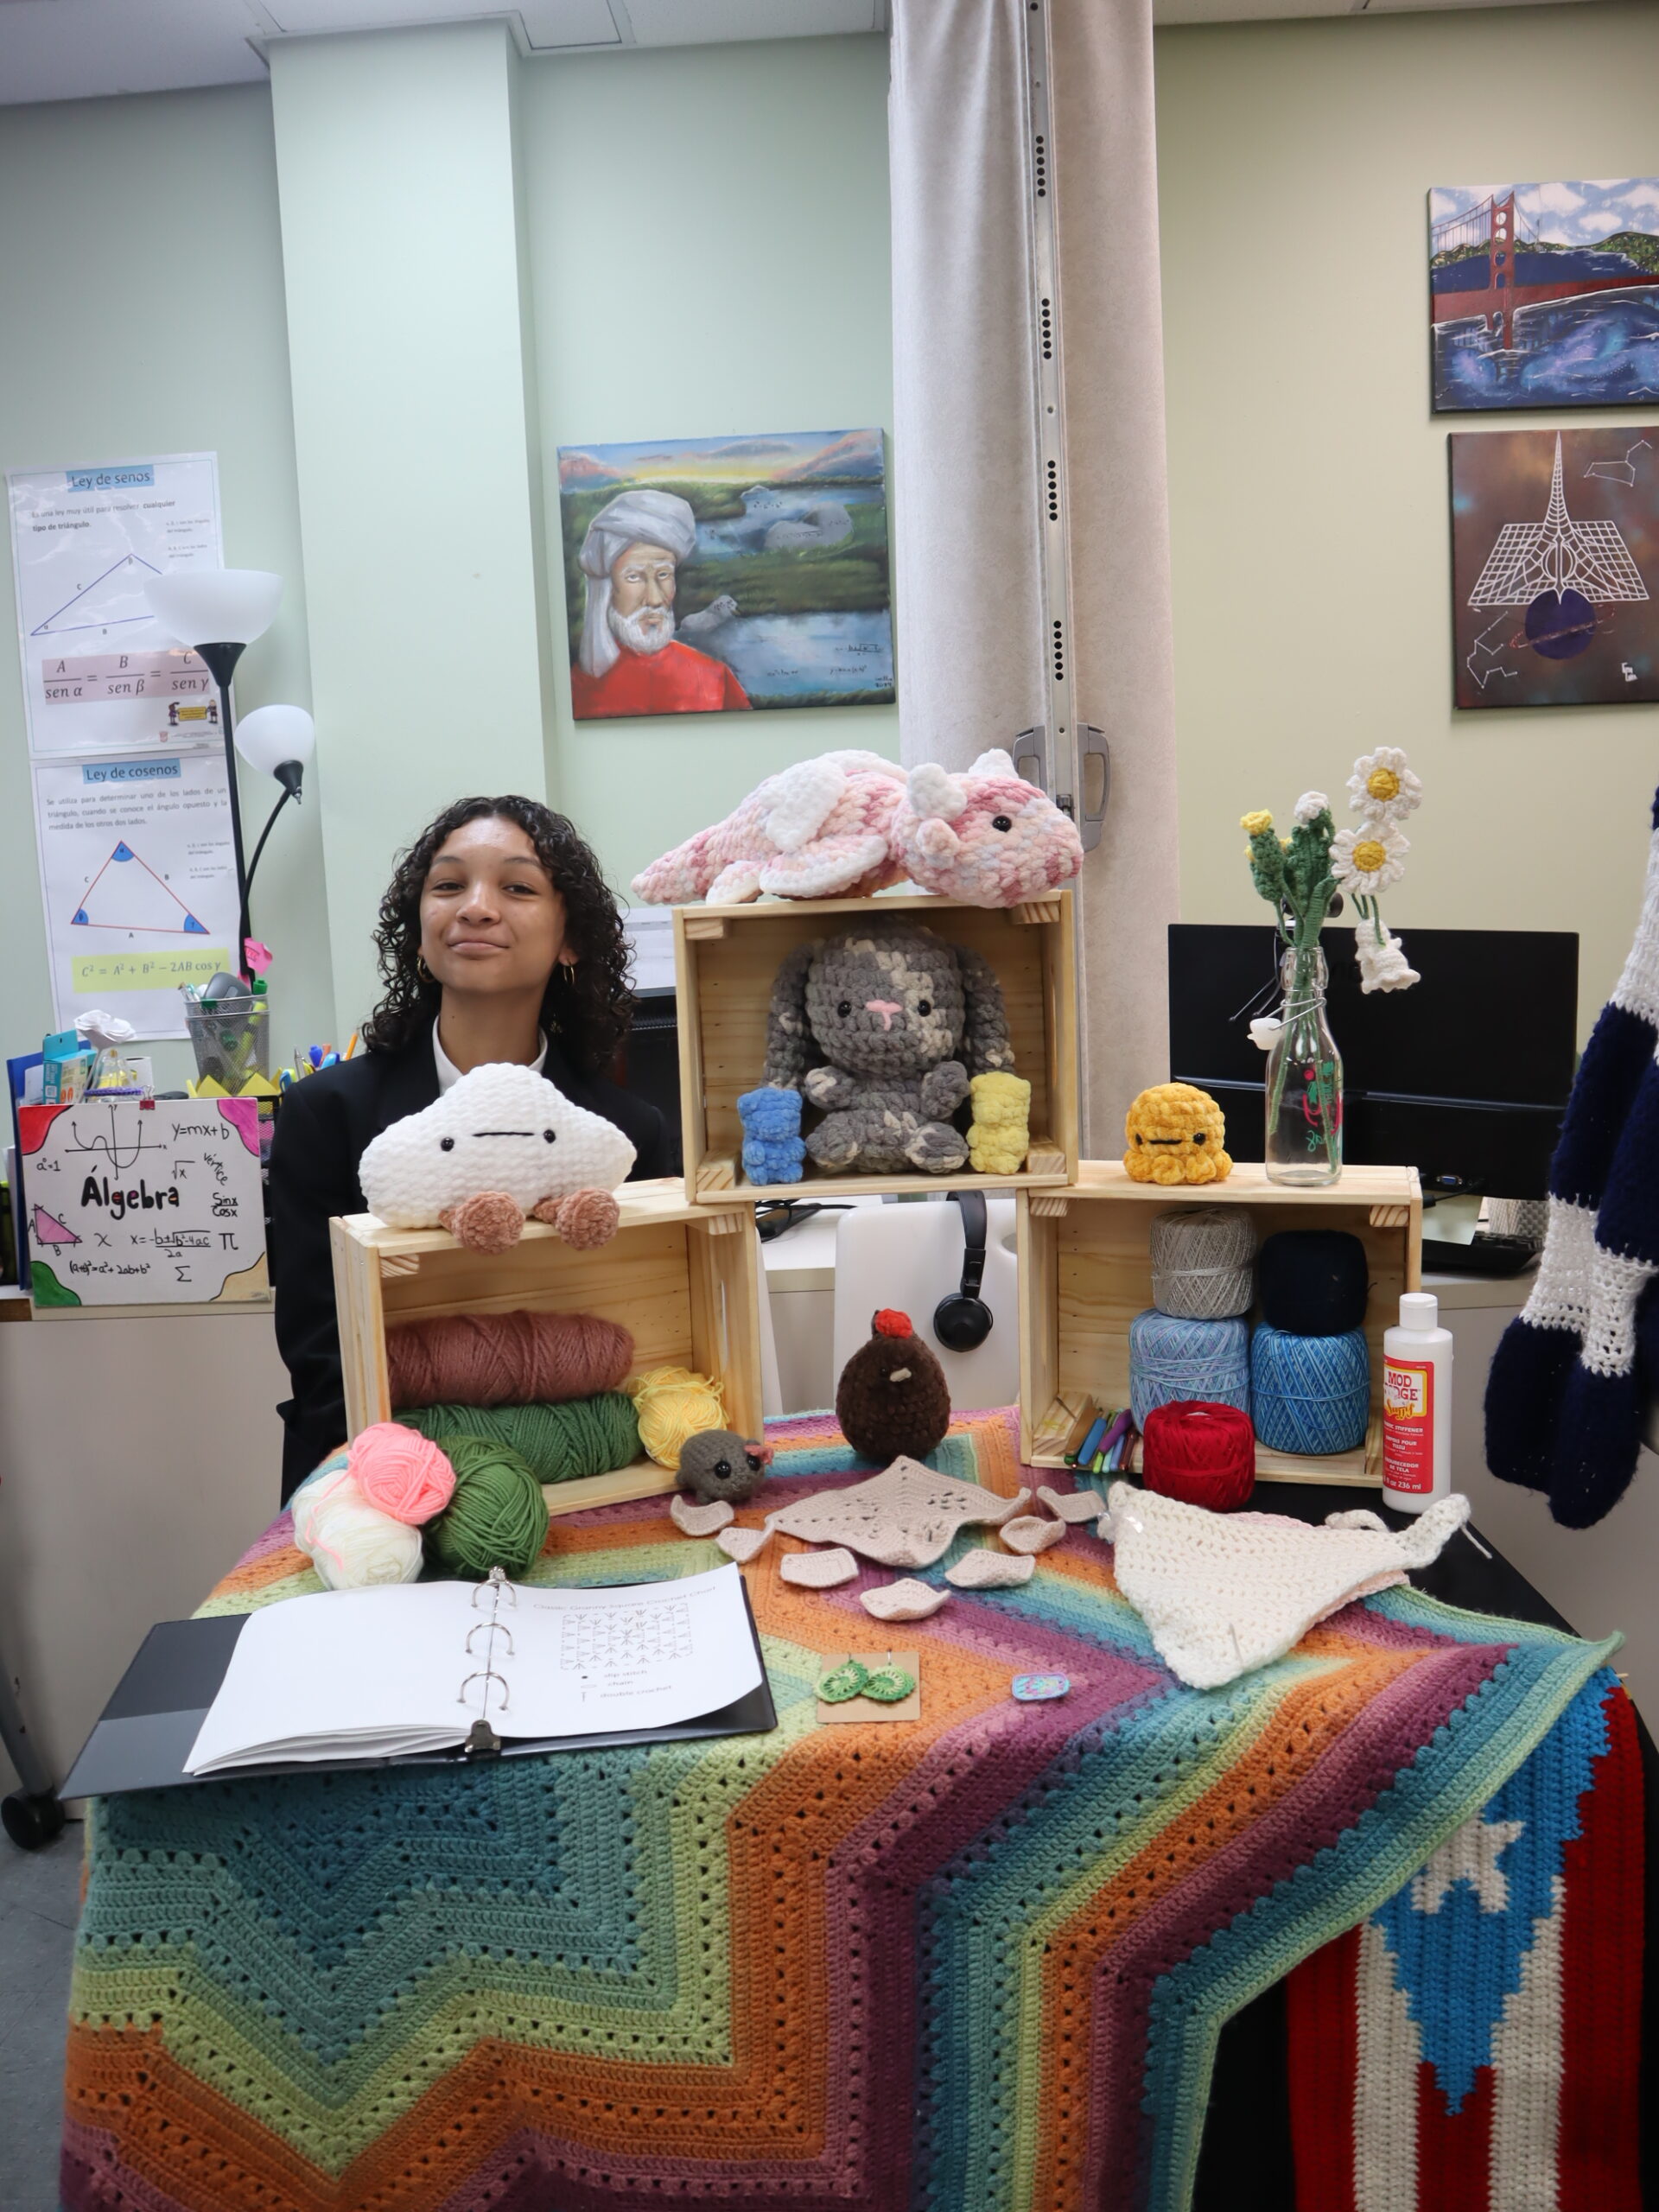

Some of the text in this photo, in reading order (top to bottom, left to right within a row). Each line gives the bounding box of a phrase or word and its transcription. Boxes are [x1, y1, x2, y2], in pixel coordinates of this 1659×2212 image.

[72, 473, 149, 488] Ley de senos
[143, 500, 175, 509] cualquier
[56, 660, 65, 672] A
[120, 655, 128, 668] B
[184, 652, 192, 664] C
[46, 688, 68, 698] sen
[108, 683, 131, 694] sen
[172, 679, 196, 690] sen
[86, 766, 178, 782] Ley de cosenos
[120, 804, 143, 813] conoce
[204, 1153, 228, 1185] vértice
[81, 1165, 180, 1220] Álgebra
[28, 1219, 35, 1233] A
[58, 1213, 67, 1224] C
[53, 1245, 61, 1256] B
[1389, 1371, 1412, 1387] MOD
